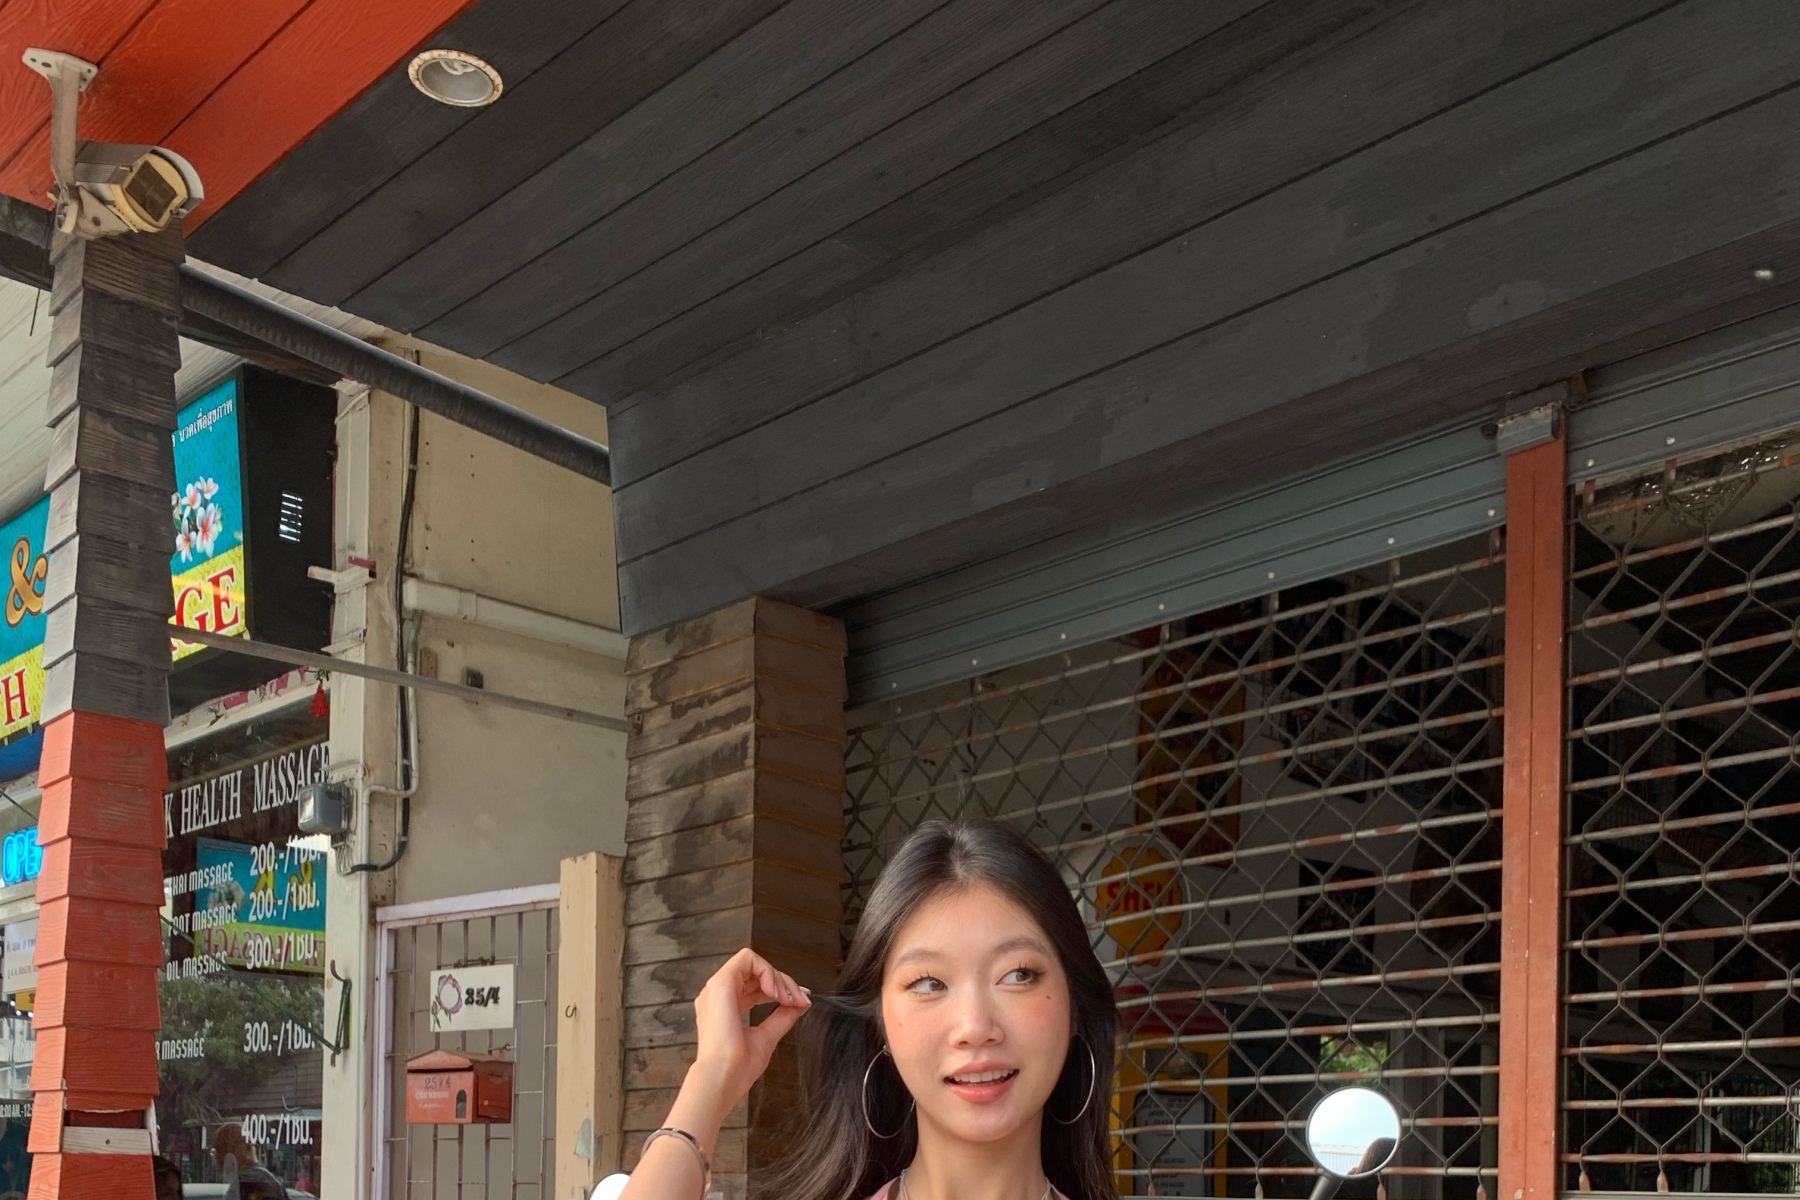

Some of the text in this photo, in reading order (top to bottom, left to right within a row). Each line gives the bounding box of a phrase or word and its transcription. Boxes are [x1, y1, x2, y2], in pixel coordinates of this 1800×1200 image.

[5, 535, 48, 628] &
[171, 567, 239, 652] GE
[180, 769, 243, 835] HEALTH
[253, 741, 330, 814] MASSAGE
[189, 861, 234, 892] MASSAGE
[192, 903, 237, 932] MASSAGE
[167, 960, 181, 981] OIL
[162, 1037, 205, 1060] MASSAGE
